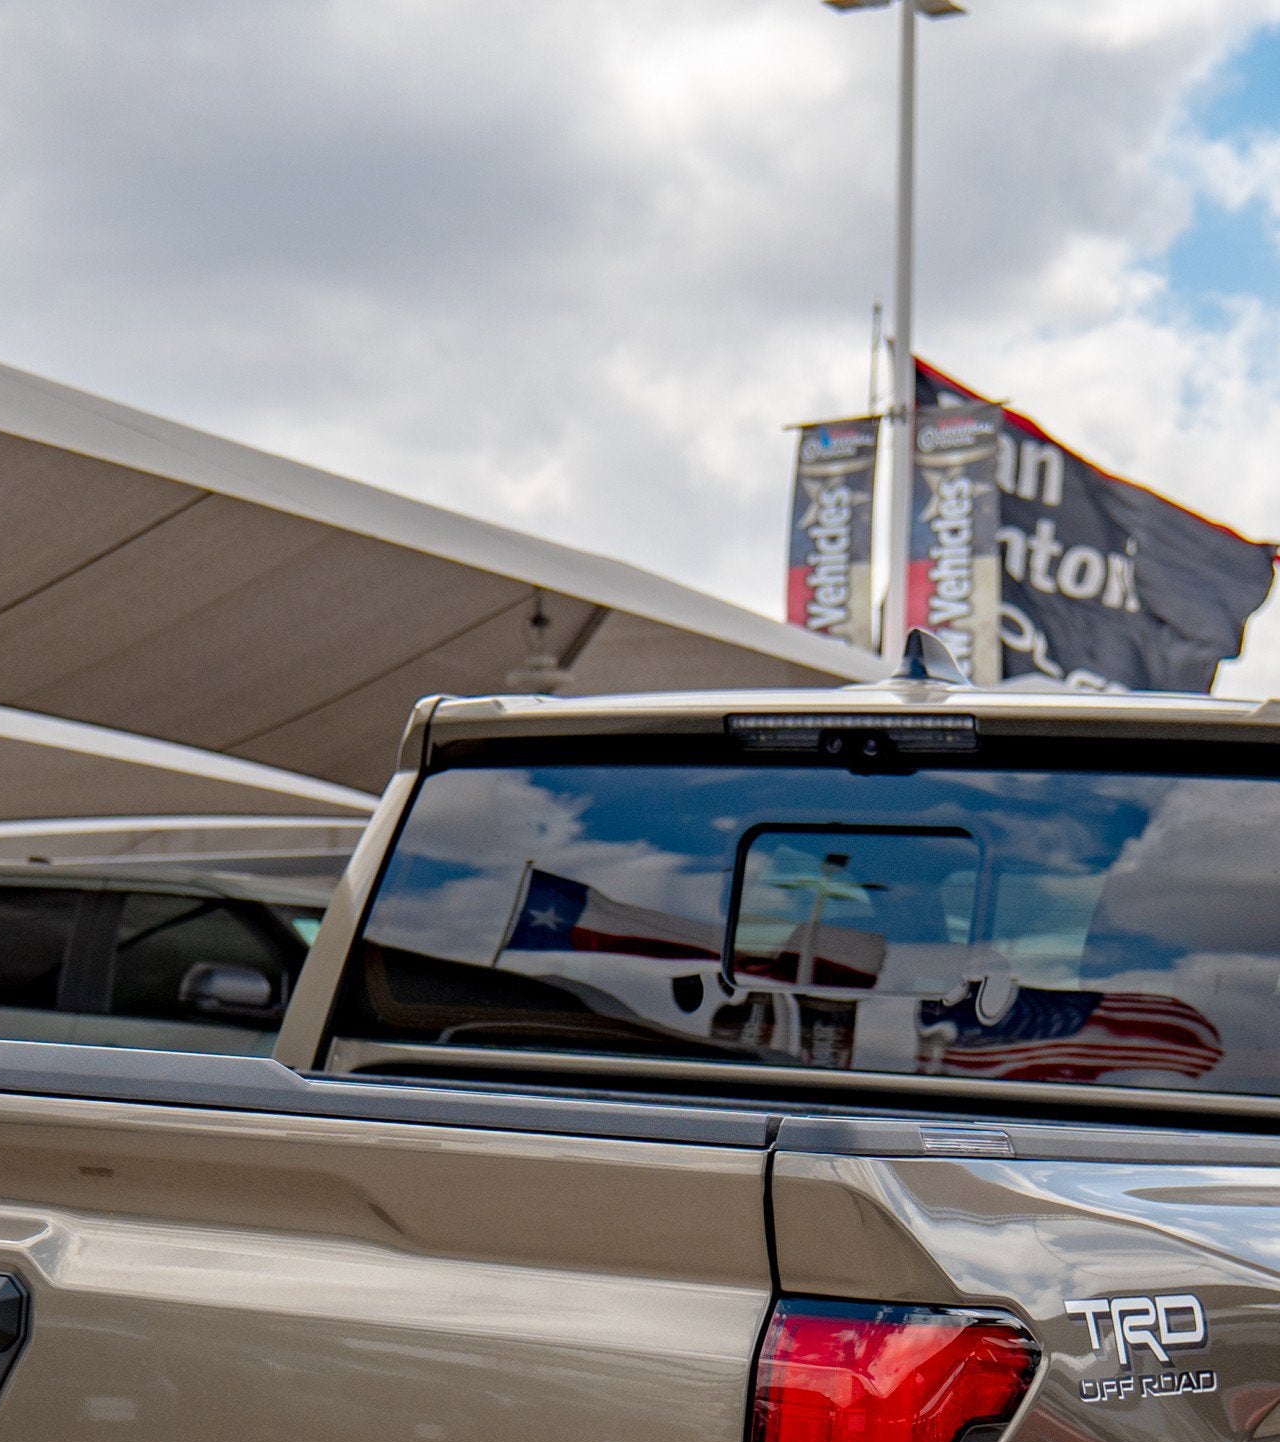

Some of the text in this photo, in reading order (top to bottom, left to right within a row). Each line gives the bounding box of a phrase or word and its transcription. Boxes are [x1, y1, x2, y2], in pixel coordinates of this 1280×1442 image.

[928, 477, 971, 626] Vehicles
[1063, 1293, 1209, 1370] TRD
[1079, 1369, 1218, 1403] OFF ROAD
